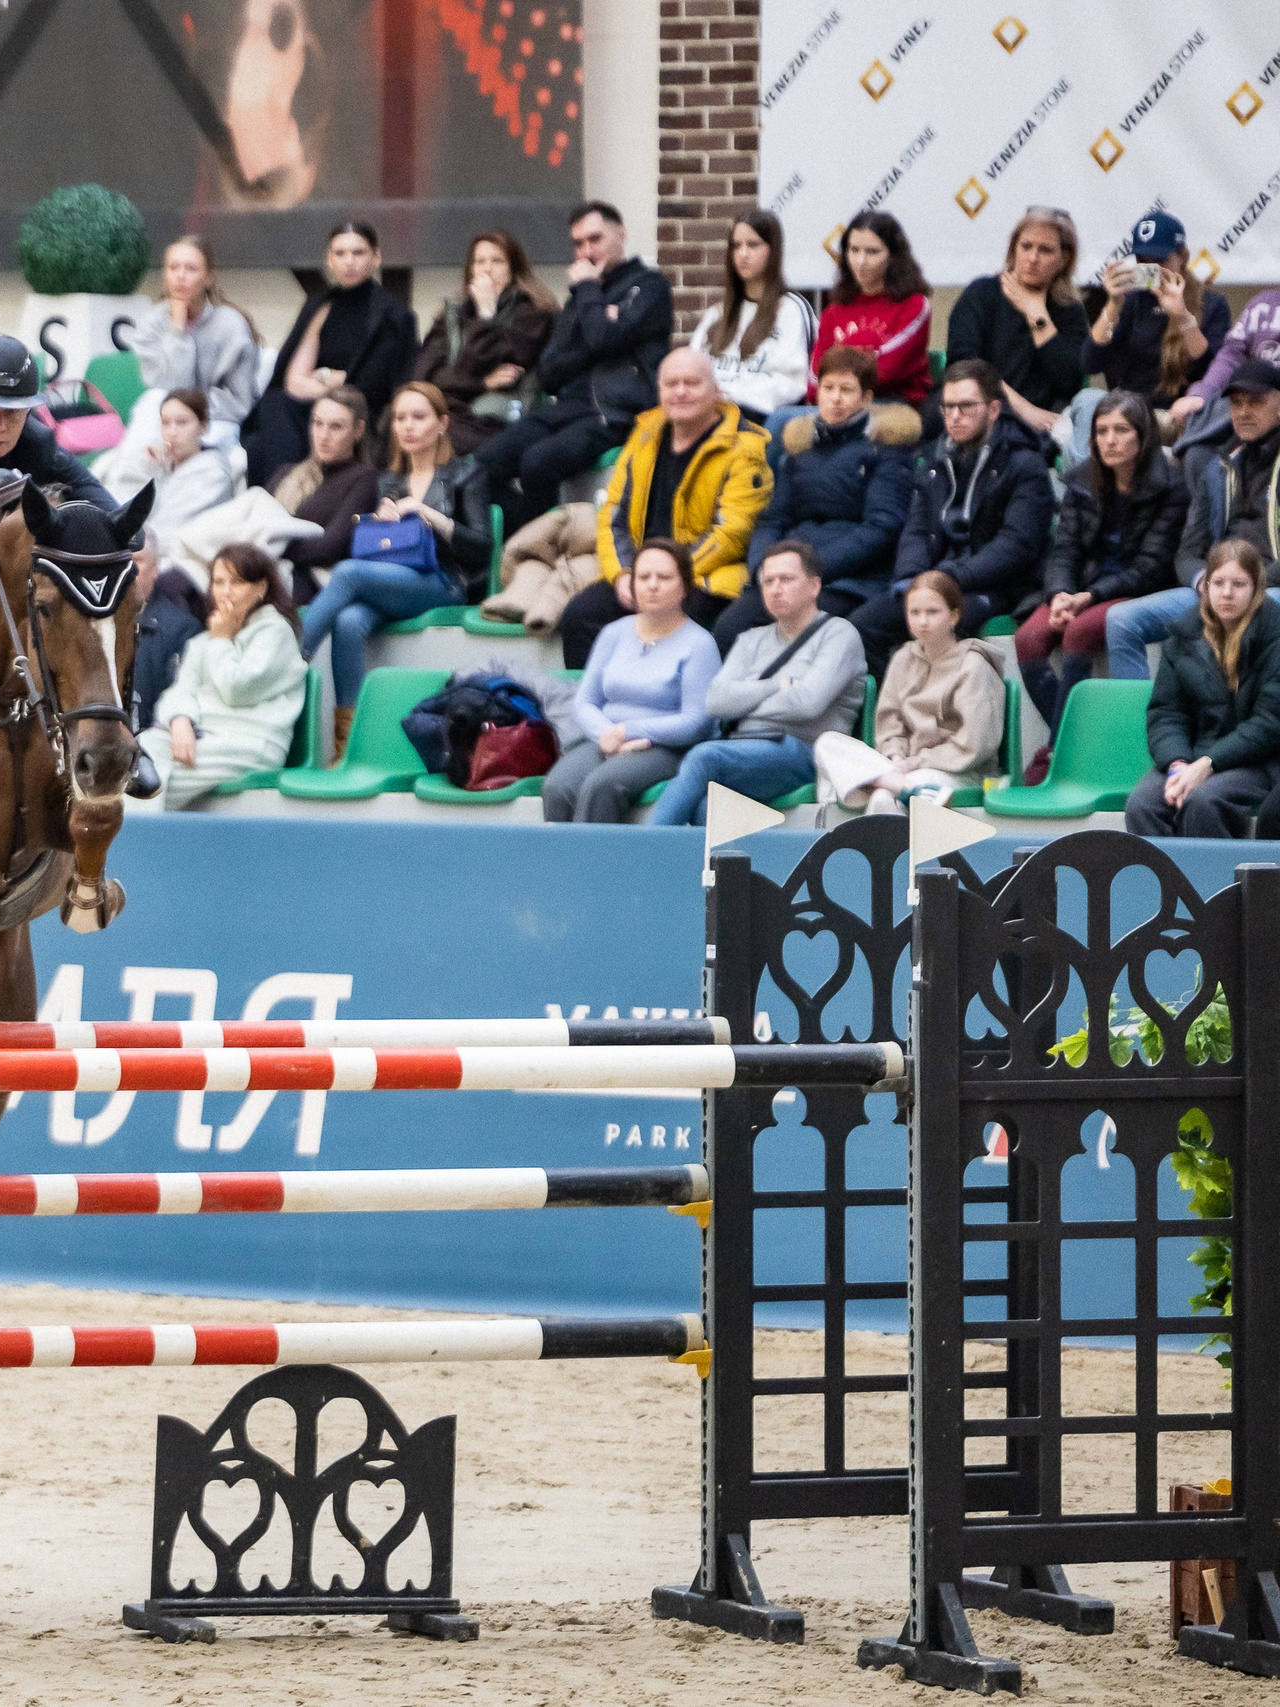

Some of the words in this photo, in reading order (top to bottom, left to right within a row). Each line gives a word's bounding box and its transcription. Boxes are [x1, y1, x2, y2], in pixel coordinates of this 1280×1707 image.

[761, 50, 809, 110] VENEZIA
[1118, 70, 1173, 133] VENEZIA
[984, 117, 1038, 180] VENEZIA
[1217, 190, 1271, 253] VENEZIA
[603, 1122, 691, 1149] PARK
